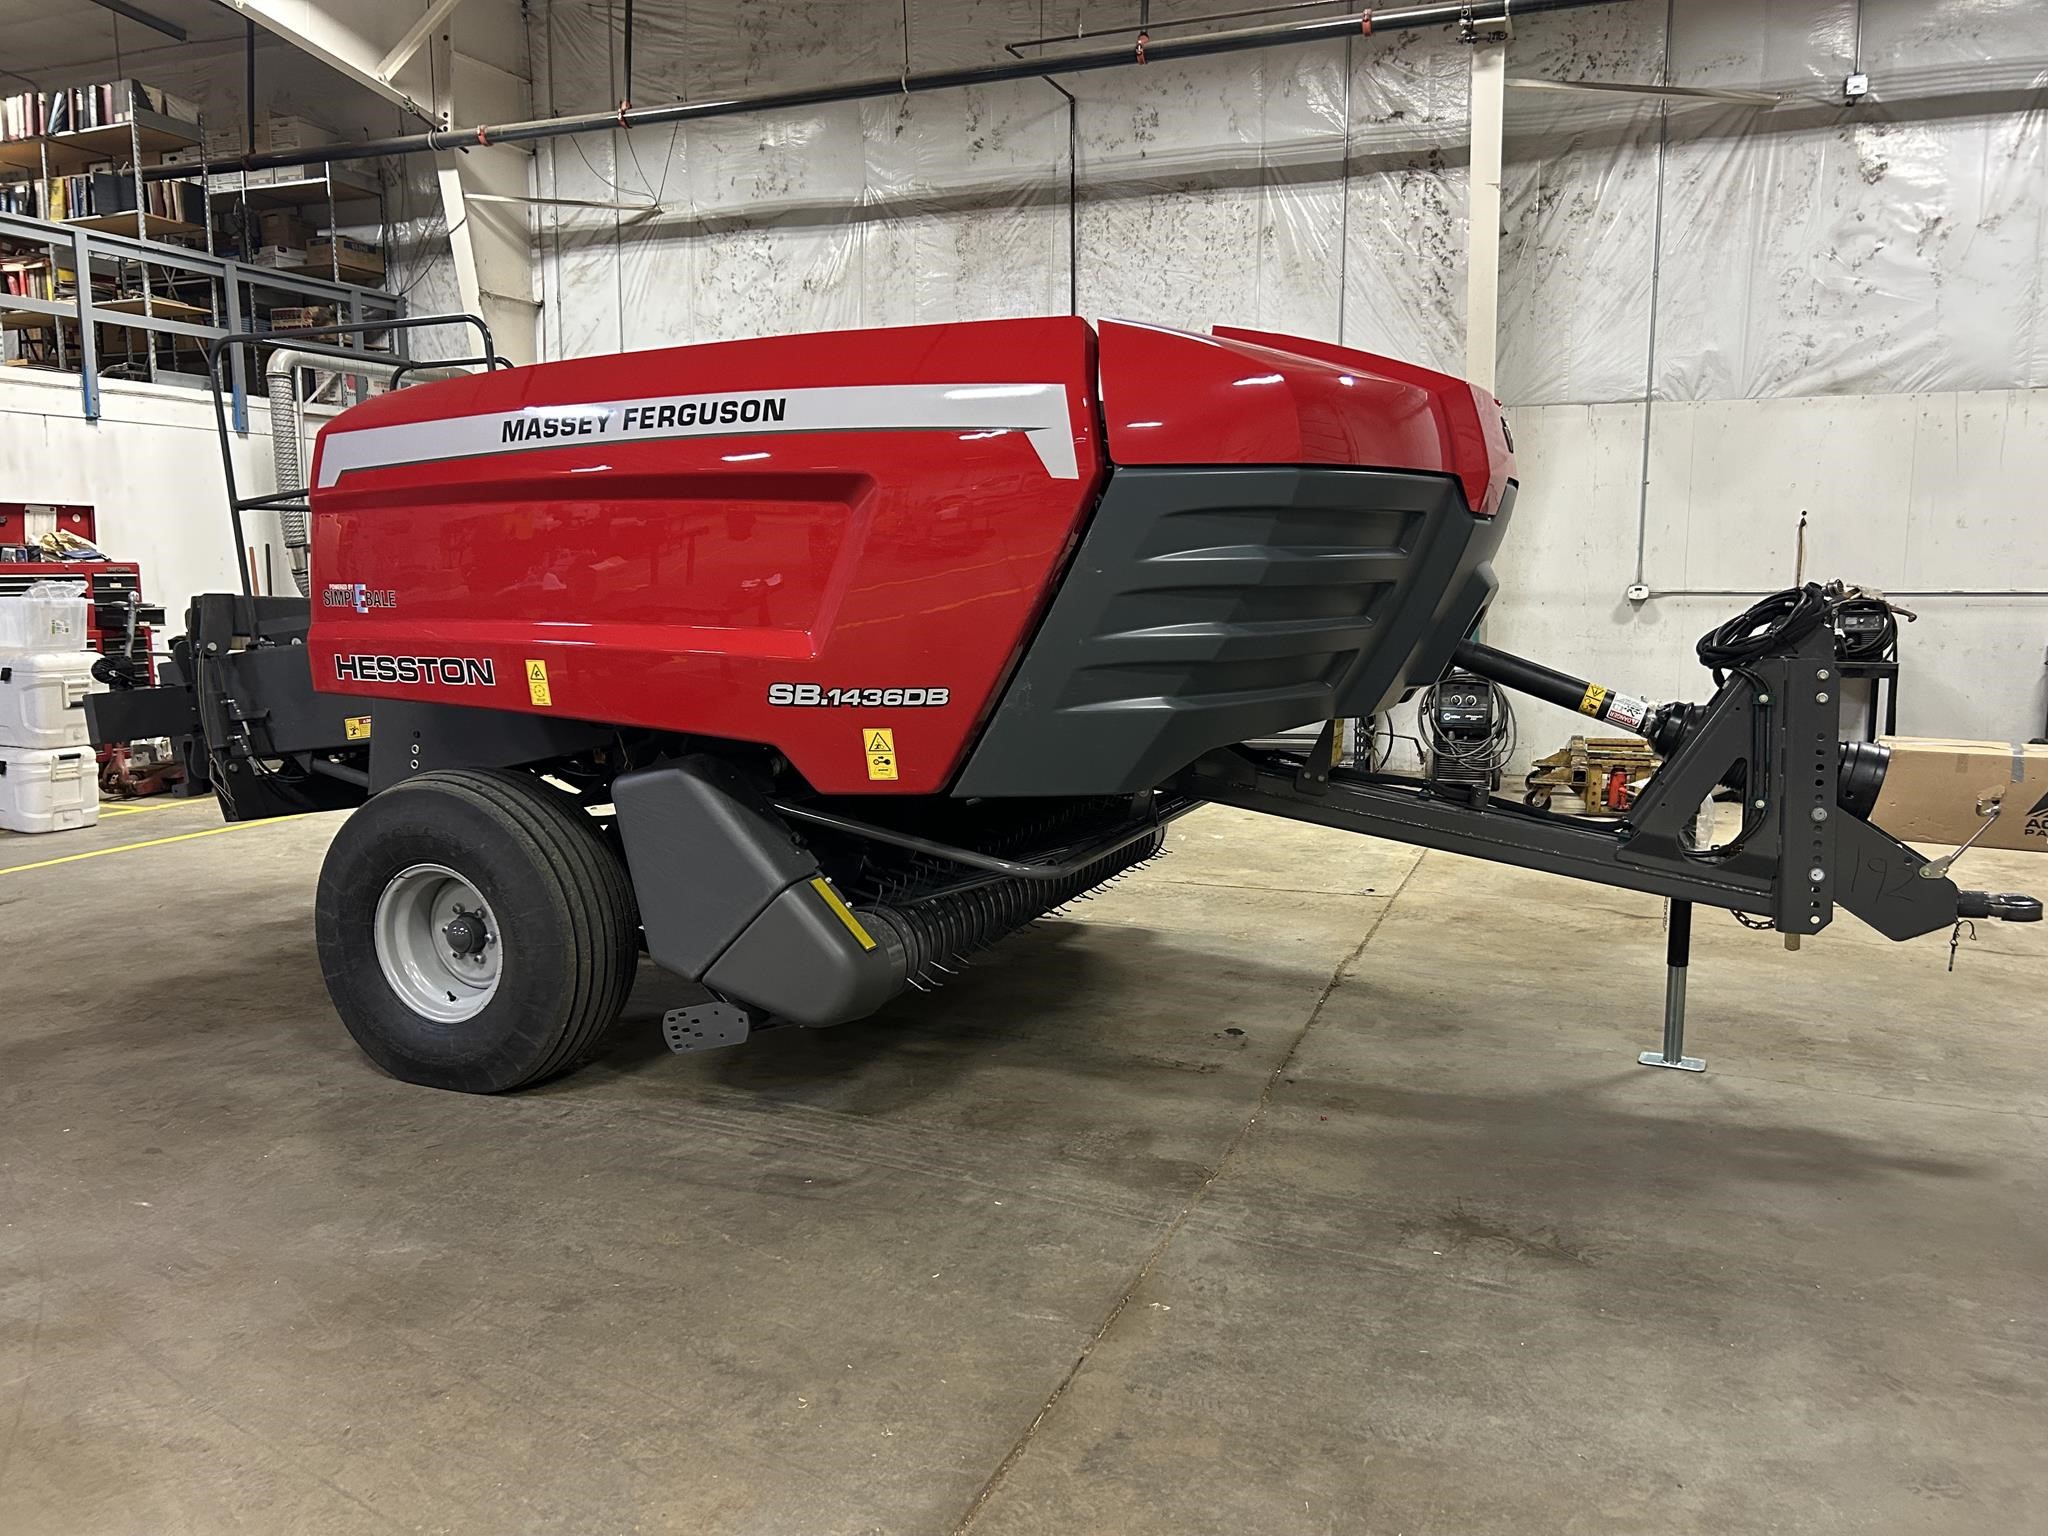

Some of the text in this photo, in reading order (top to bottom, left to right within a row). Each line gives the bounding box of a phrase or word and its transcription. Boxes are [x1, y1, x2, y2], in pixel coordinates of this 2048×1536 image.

[502, 398, 787, 443] MASSEY FERGUSON
[334, 653, 497, 686] HESSTON
[767, 682, 950, 707] SB.1436DB
